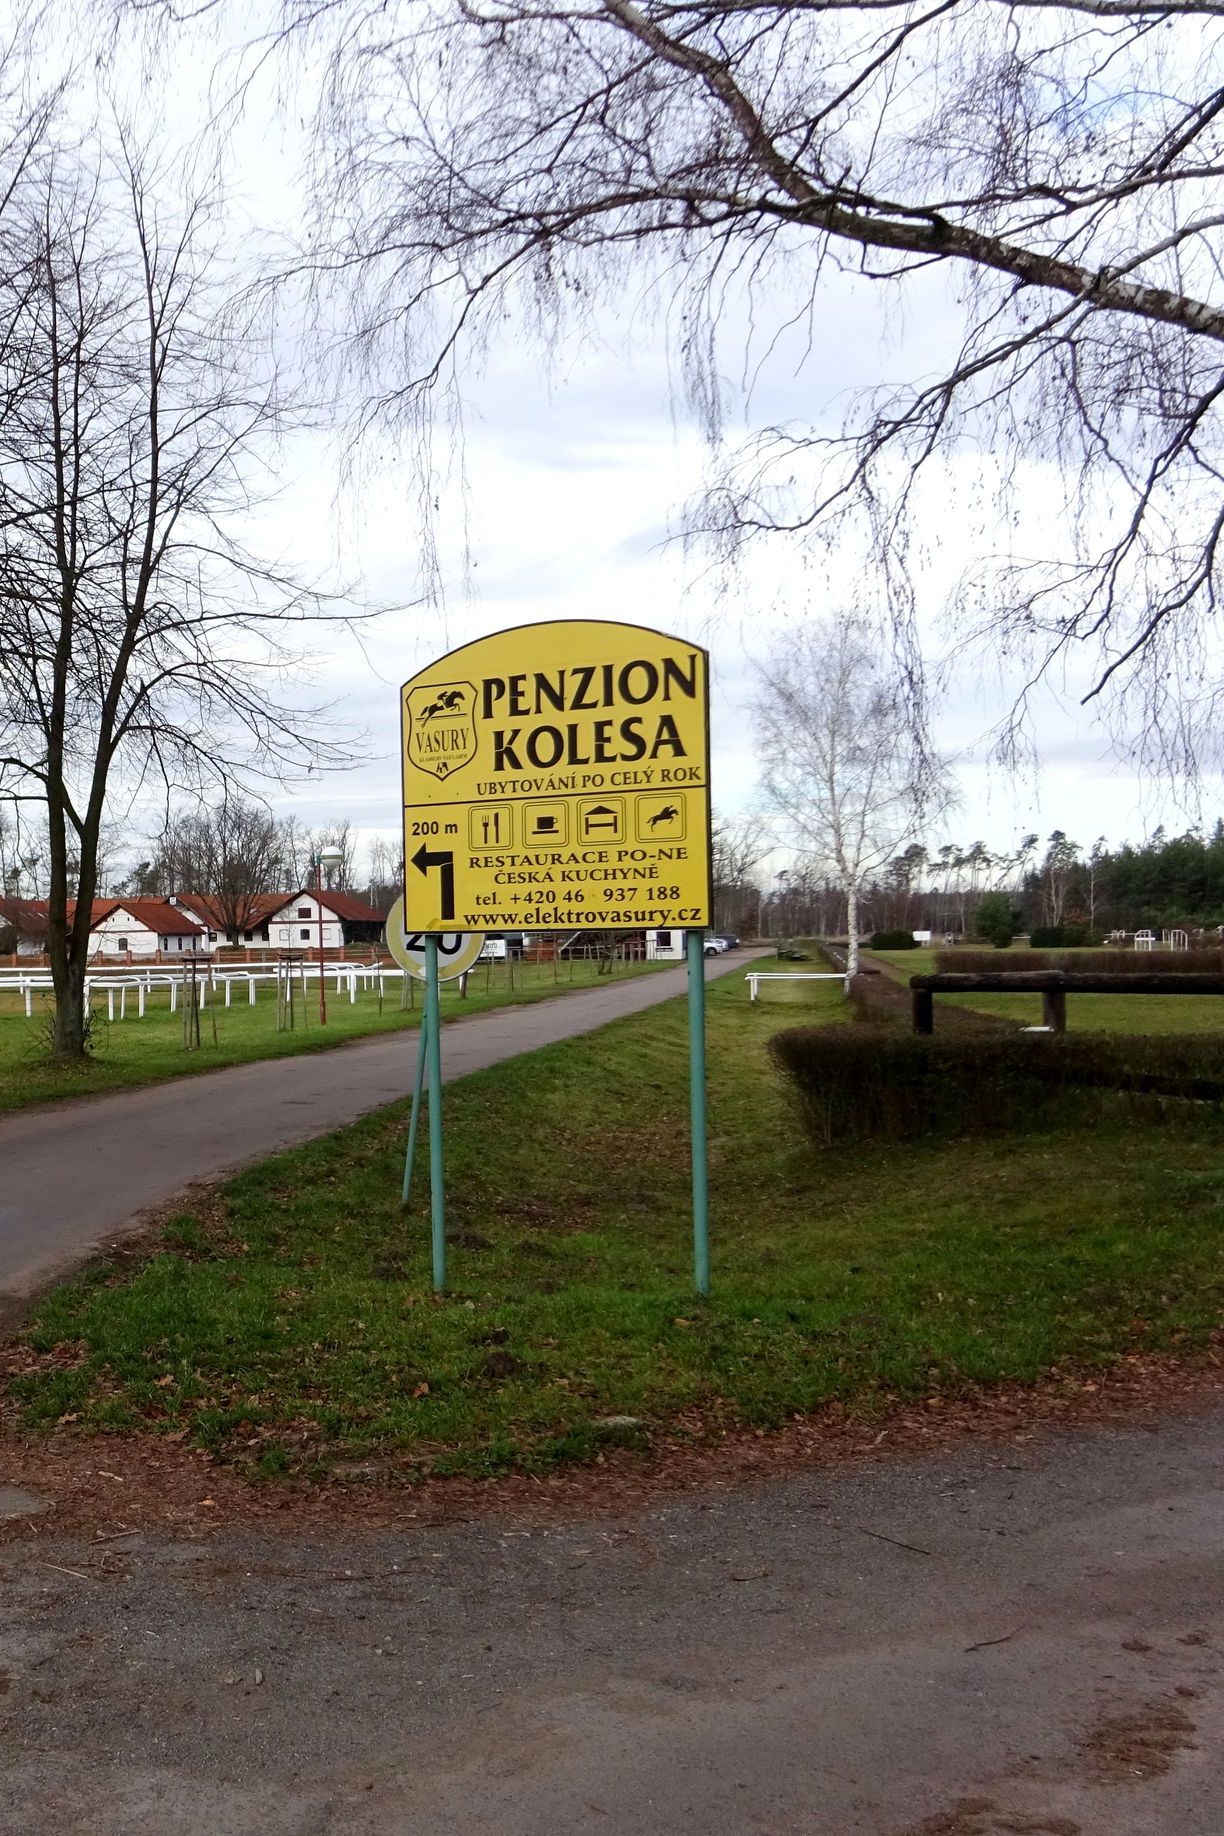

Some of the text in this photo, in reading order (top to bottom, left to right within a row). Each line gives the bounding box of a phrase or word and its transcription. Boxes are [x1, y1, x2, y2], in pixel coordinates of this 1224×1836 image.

[481, 654, 697, 719] PENZION
[416, 728, 469, 753] VASURY
[492, 714, 688, 772] KOLESA
[476, 766, 701, 796] UBYTOVÁNÍ PO CELÝ ROK
[411, 821, 458, 836] 200 m
[468, 847, 688, 869] RESTAURACE PO-NE
[494, 863, 660, 885] ČESKÁ KUCHYNĚ
[475, 885, 680, 906] tel. +420 46 937 188
[463, 906, 702, 928] www.elektrovasury.cz
